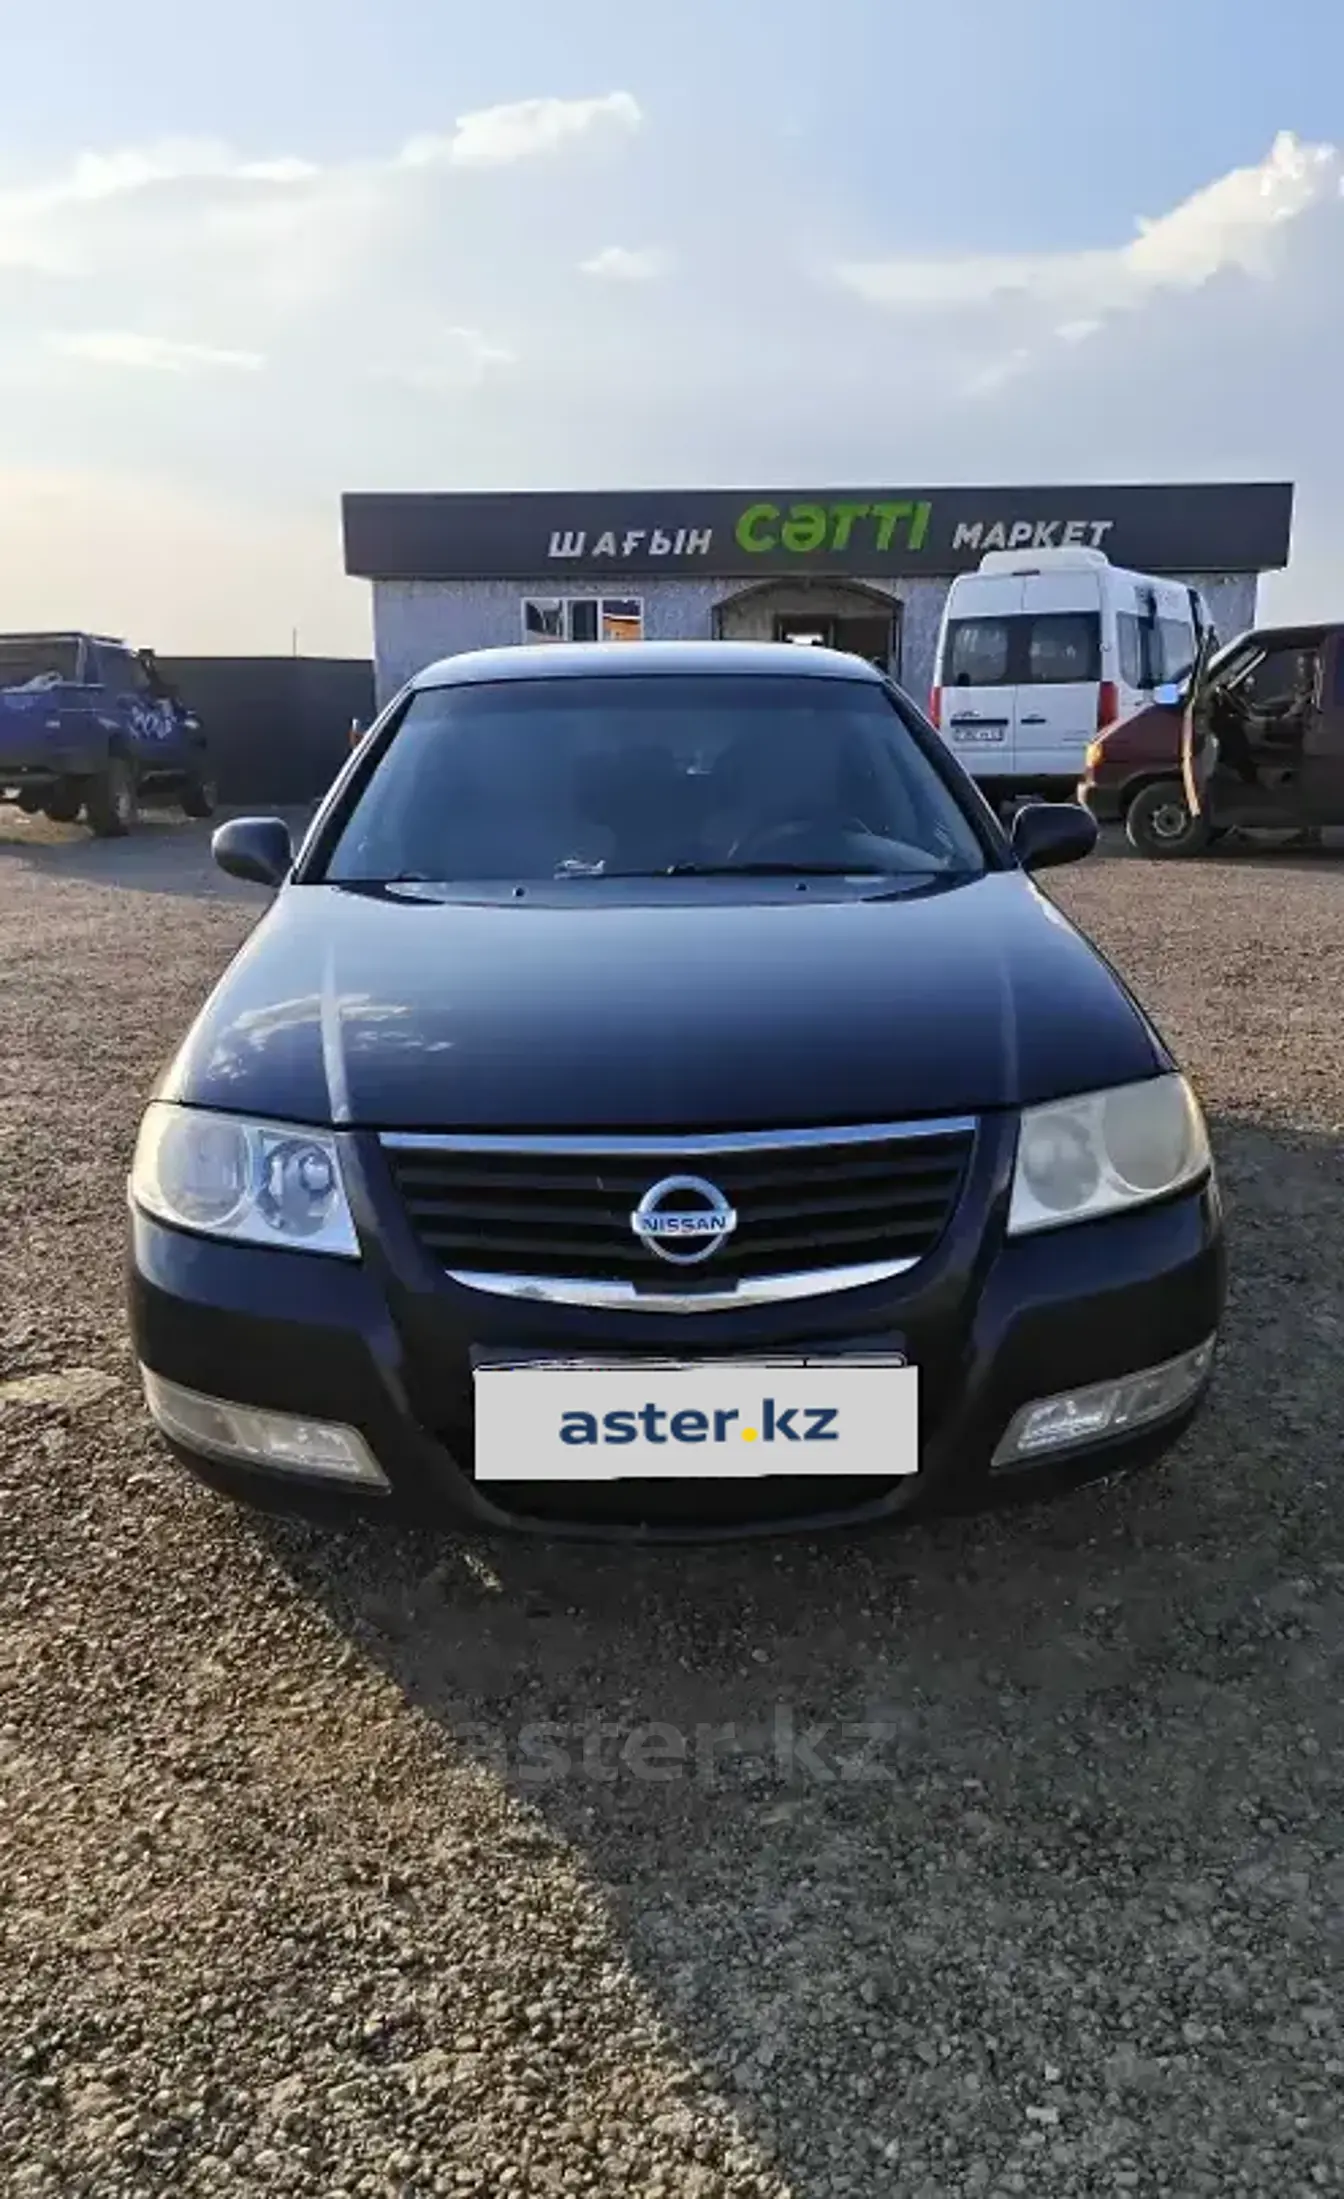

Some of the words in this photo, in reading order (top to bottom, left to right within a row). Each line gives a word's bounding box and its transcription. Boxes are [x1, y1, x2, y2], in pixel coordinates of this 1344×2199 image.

[548, 528, 713, 557] ШАҒЫН
[736, 501, 932, 552] СӘТТІ
[952, 520, 1114, 550] МАРКЕТ
[643, 1215, 726, 1232] NISSAN
